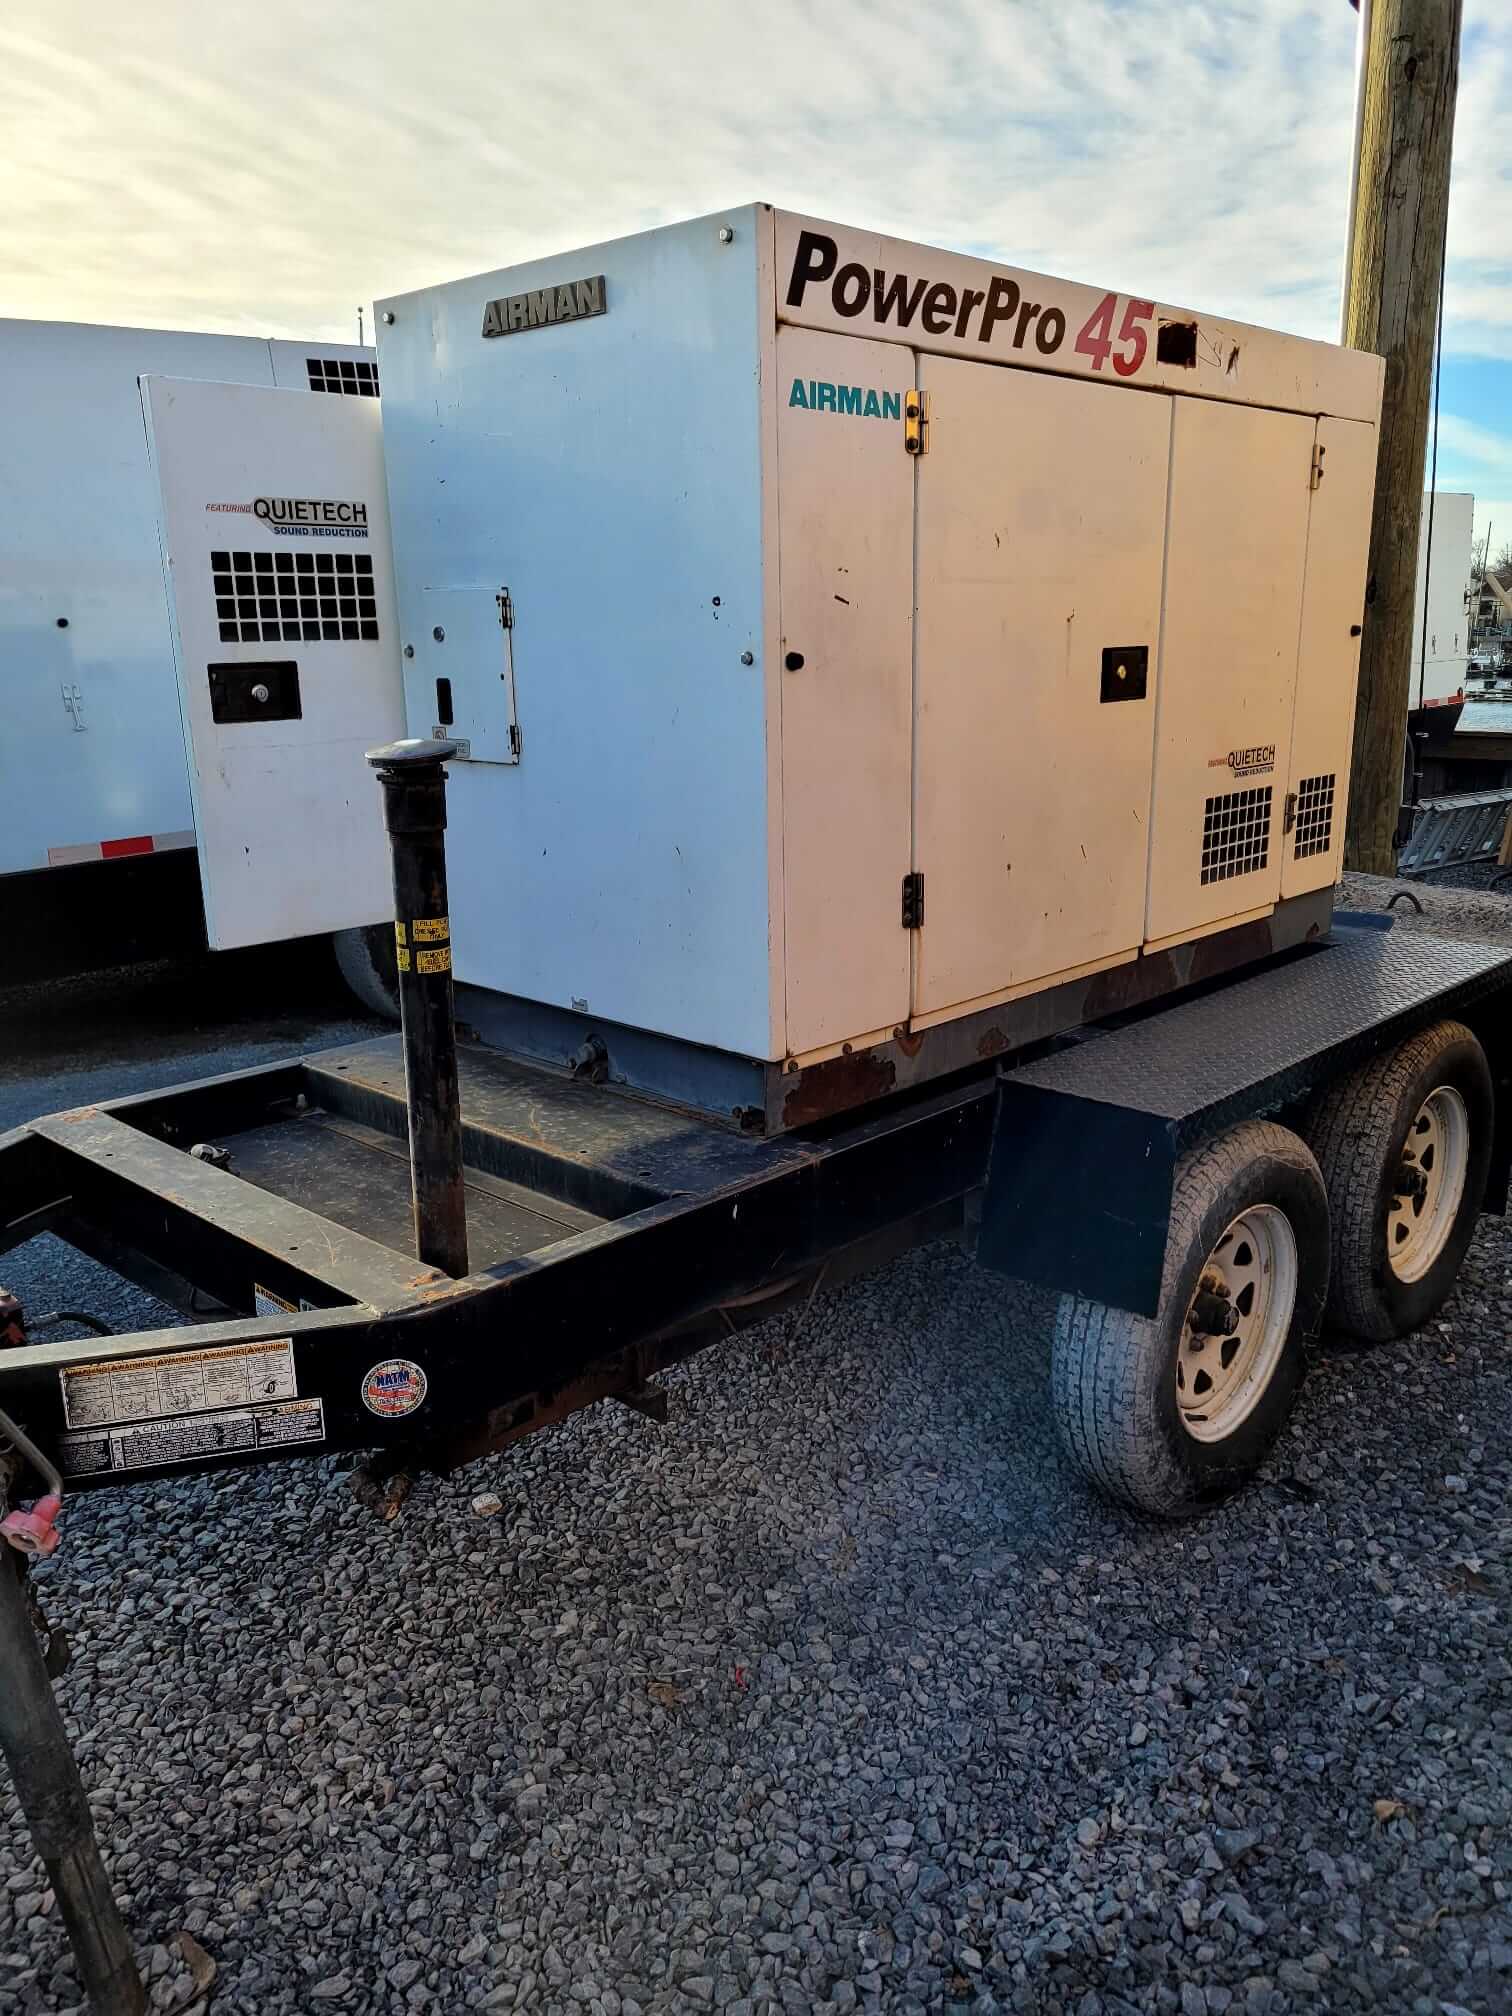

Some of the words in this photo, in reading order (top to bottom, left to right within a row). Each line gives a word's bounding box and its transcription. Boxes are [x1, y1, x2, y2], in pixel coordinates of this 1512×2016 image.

[482, 277, 602, 337] AIRMAN
[785, 230, 1066, 355] PowerPro
[1074, 292, 1156, 377] 45
[789, 378, 901, 420] AIRMAN
[205, 503, 251, 513] FEATURING
[254, 499, 368, 523] QUIETECH
[274, 527, 309, 536] SOUND
[312, 528, 368, 537] REDUCTION
[1228, 744, 1276, 769] QUIETECH
[208, 1348, 245, 1359] WARNING
[254, 1342, 289, 1353] WARNING
[119, 1360, 154, 1371] WARNING
[165, 1354, 201, 1365] WARNING
[142, 1420, 186, 1433] CAUTION
